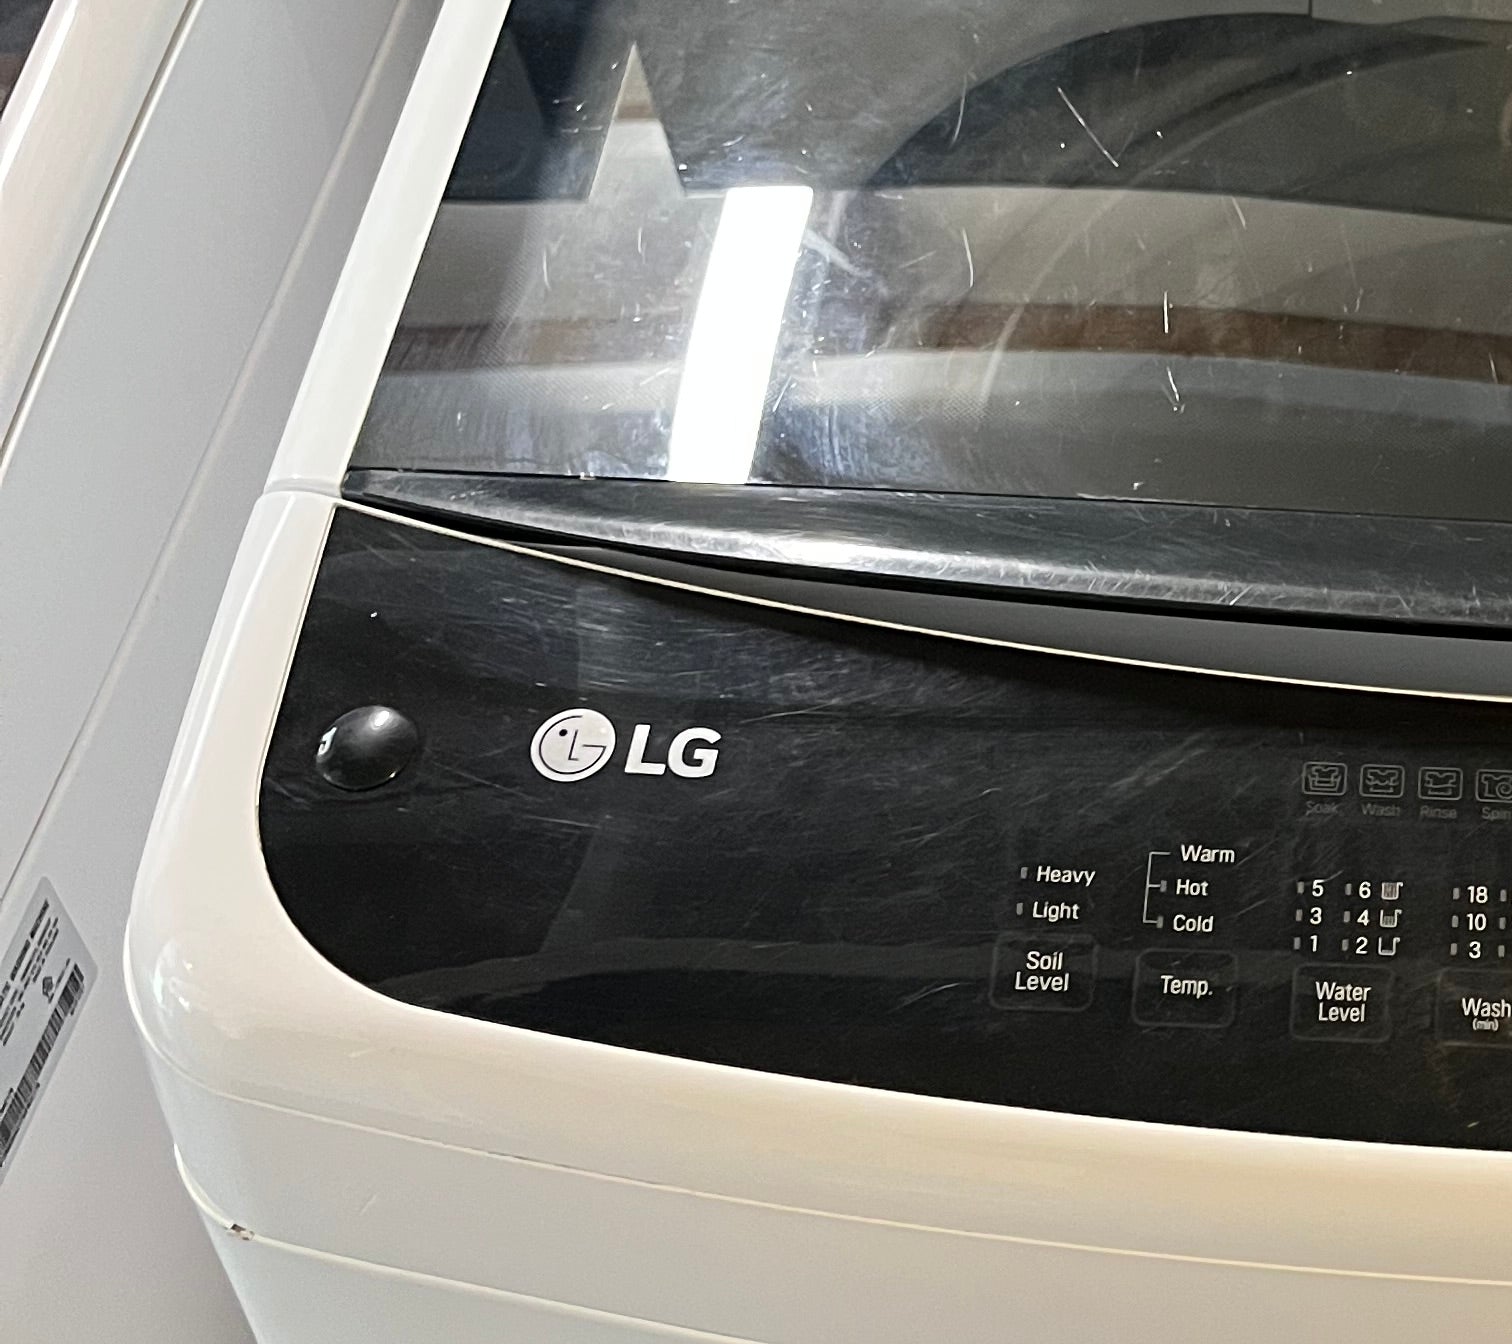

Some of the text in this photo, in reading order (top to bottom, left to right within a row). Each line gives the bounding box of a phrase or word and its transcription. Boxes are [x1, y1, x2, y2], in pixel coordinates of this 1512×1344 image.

[624, 724, 722, 778] LG
[1361, 802, 1401, 817] Wash
[1420, 805, 1457, 819] Rinse
[1482, 806, 1512, 821] Spin
[1180, 844, 1235, 863] Warm
[1036, 865, 1096, 886] Heavy
[1176, 878, 1208, 897] Hot
[1311, 880, 1372, 898] 5 6
[1467, 886, 1488, 904] 18
[1032, 901, 1080, 922] Light
[1309, 908, 1370, 926] 3 4
[1173, 914, 1214, 933] Cold
[1466, 914, 1487, 931] 10
[1309, 935, 1368, 954] 1 2
[1468, 942, 1481, 959] 3
[1026, 951, 1063, 970] Soil
[1015, 972, 1069, 992] Level
[1161, 976, 1214, 998] Temp.
[1316, 981, 1371, 1002] Water
[1318, 1002, 1366, 1023] Level
[1462, 998, 1512, 1018] Wash
